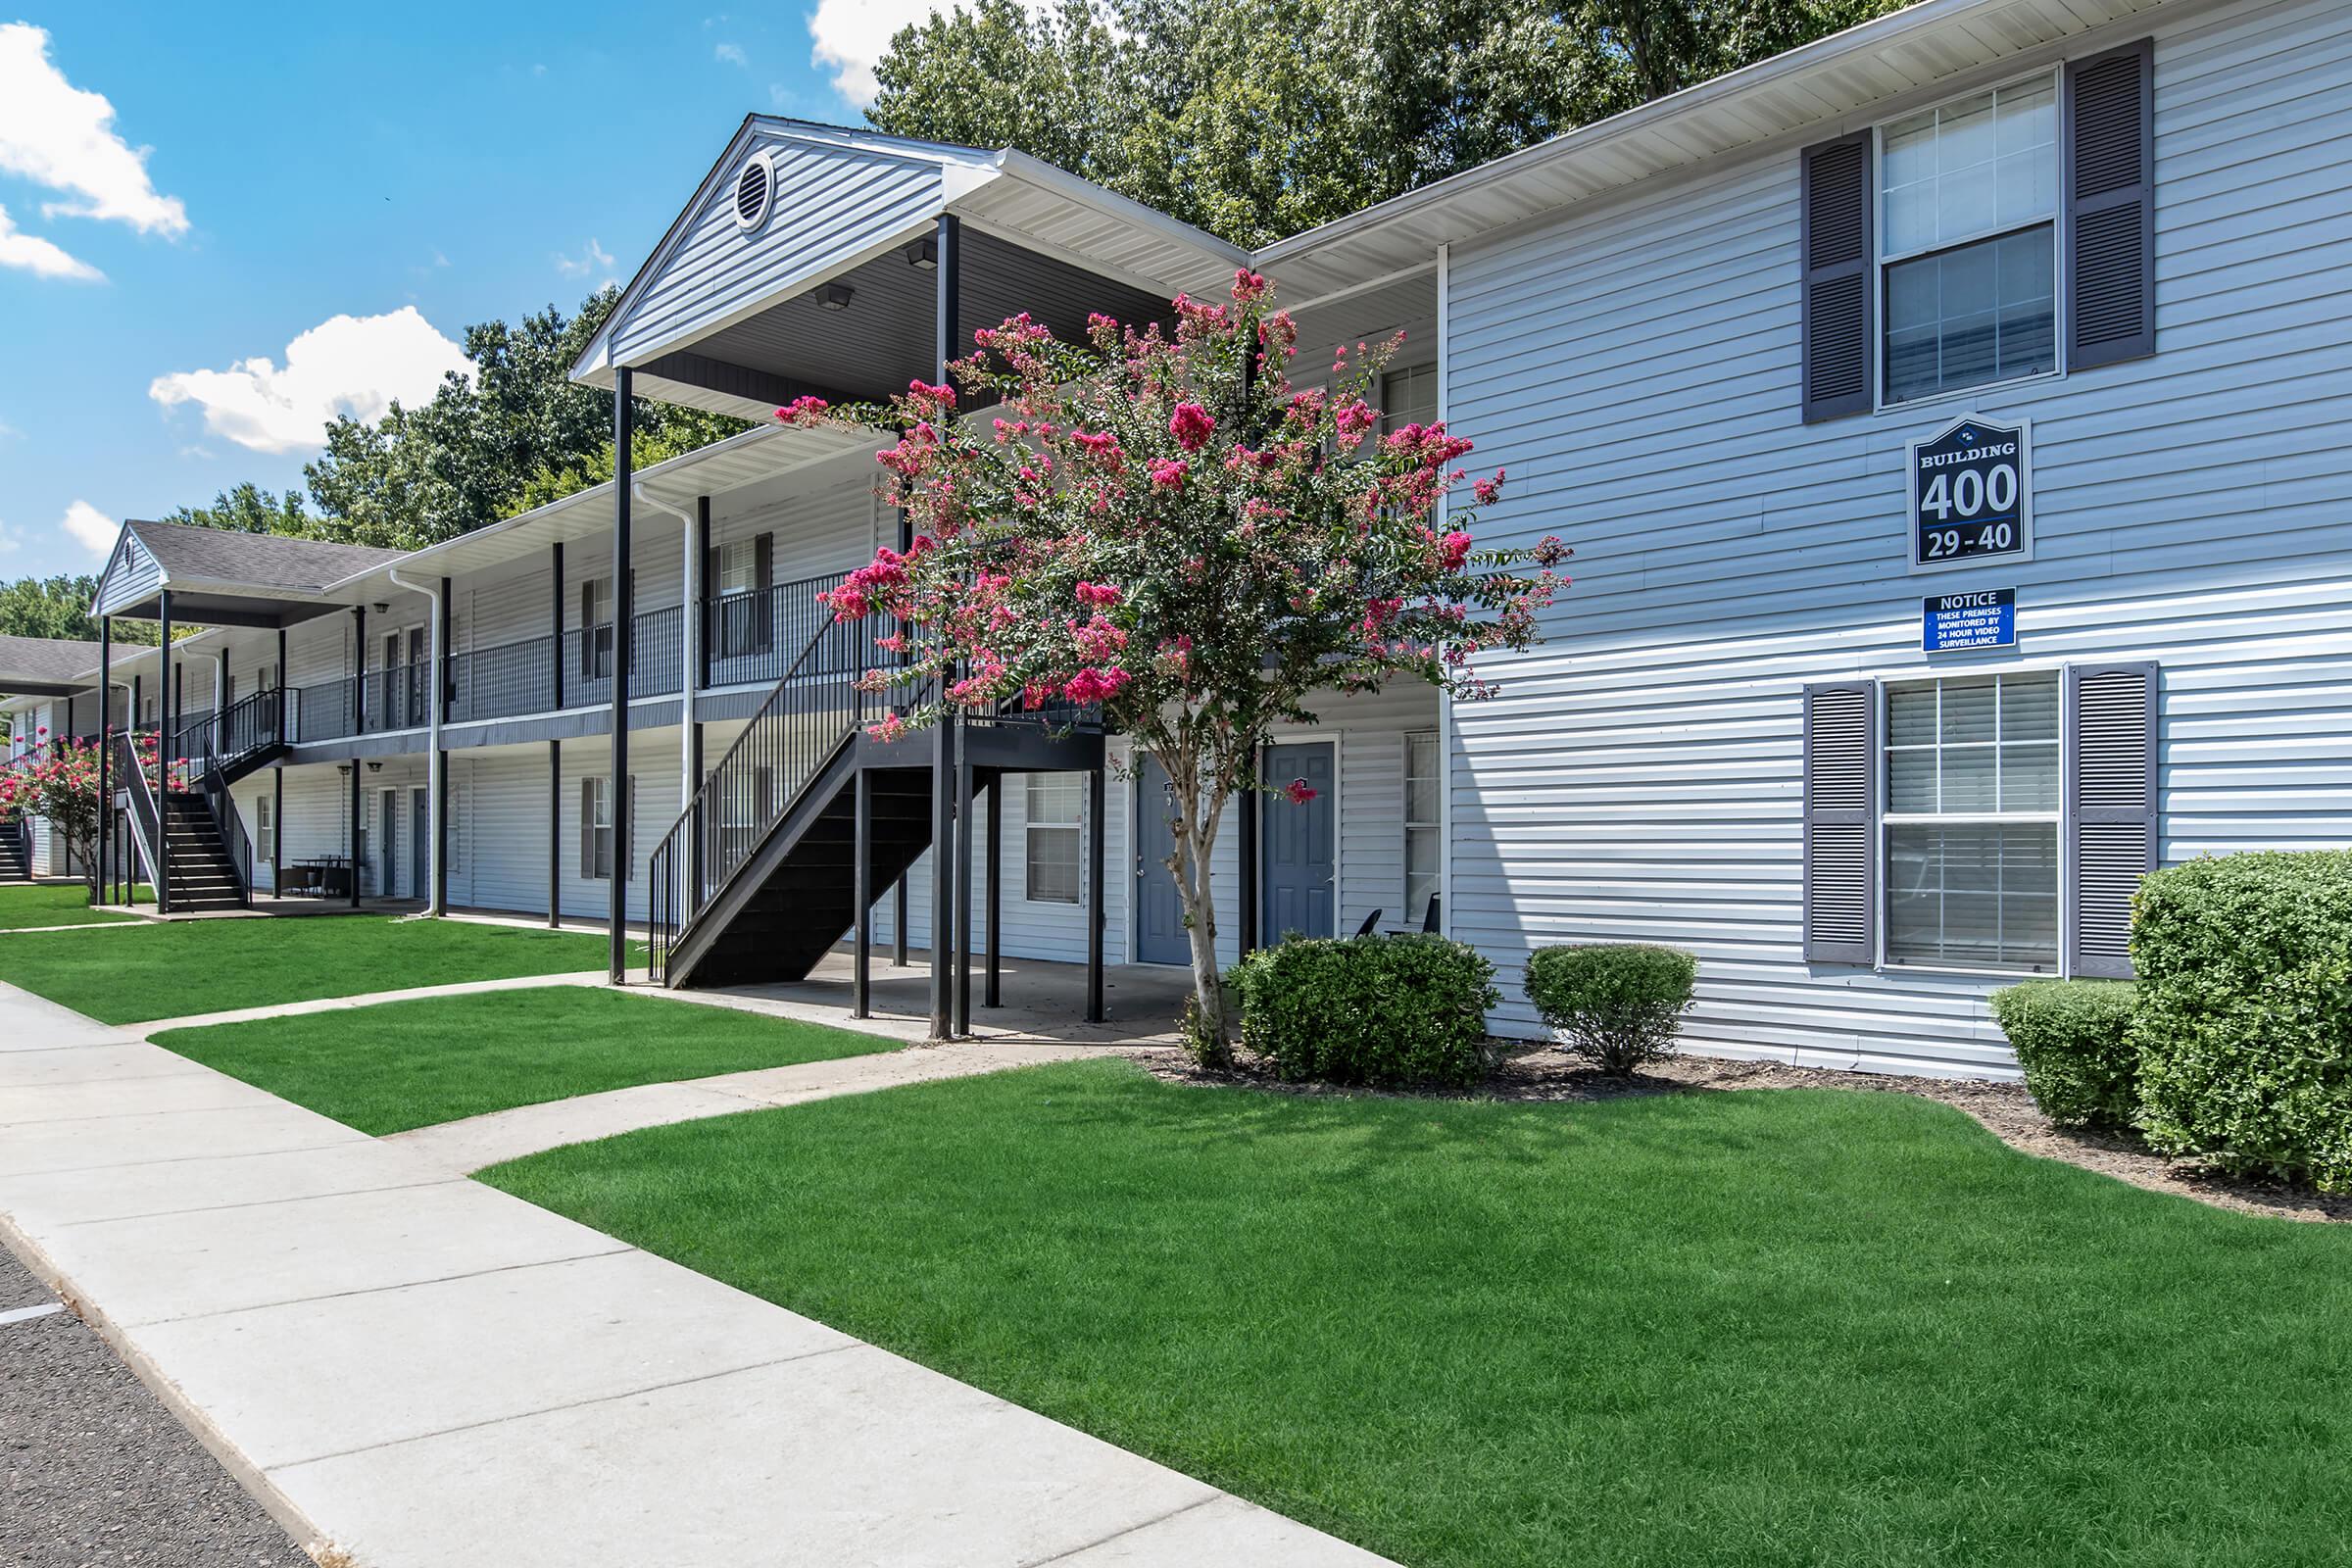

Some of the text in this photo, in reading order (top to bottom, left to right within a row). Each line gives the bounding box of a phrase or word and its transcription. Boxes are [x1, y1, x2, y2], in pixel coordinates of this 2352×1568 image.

[1921, 443, 2016, 468] BUILDING
[1921, 464, 2017, 520] 400
[1940, 592, 1997, 610] NOTICE
[1936, 607, 2002, 620] THESE PREMISES
[1937, 617, 1986, 630] MONITORED
[1949, 629, 1973, 638] HOUR
[1974, 626, 2000, 636] VIDEO
[1938, 635, 1997, 649] SURVEILLANCE
